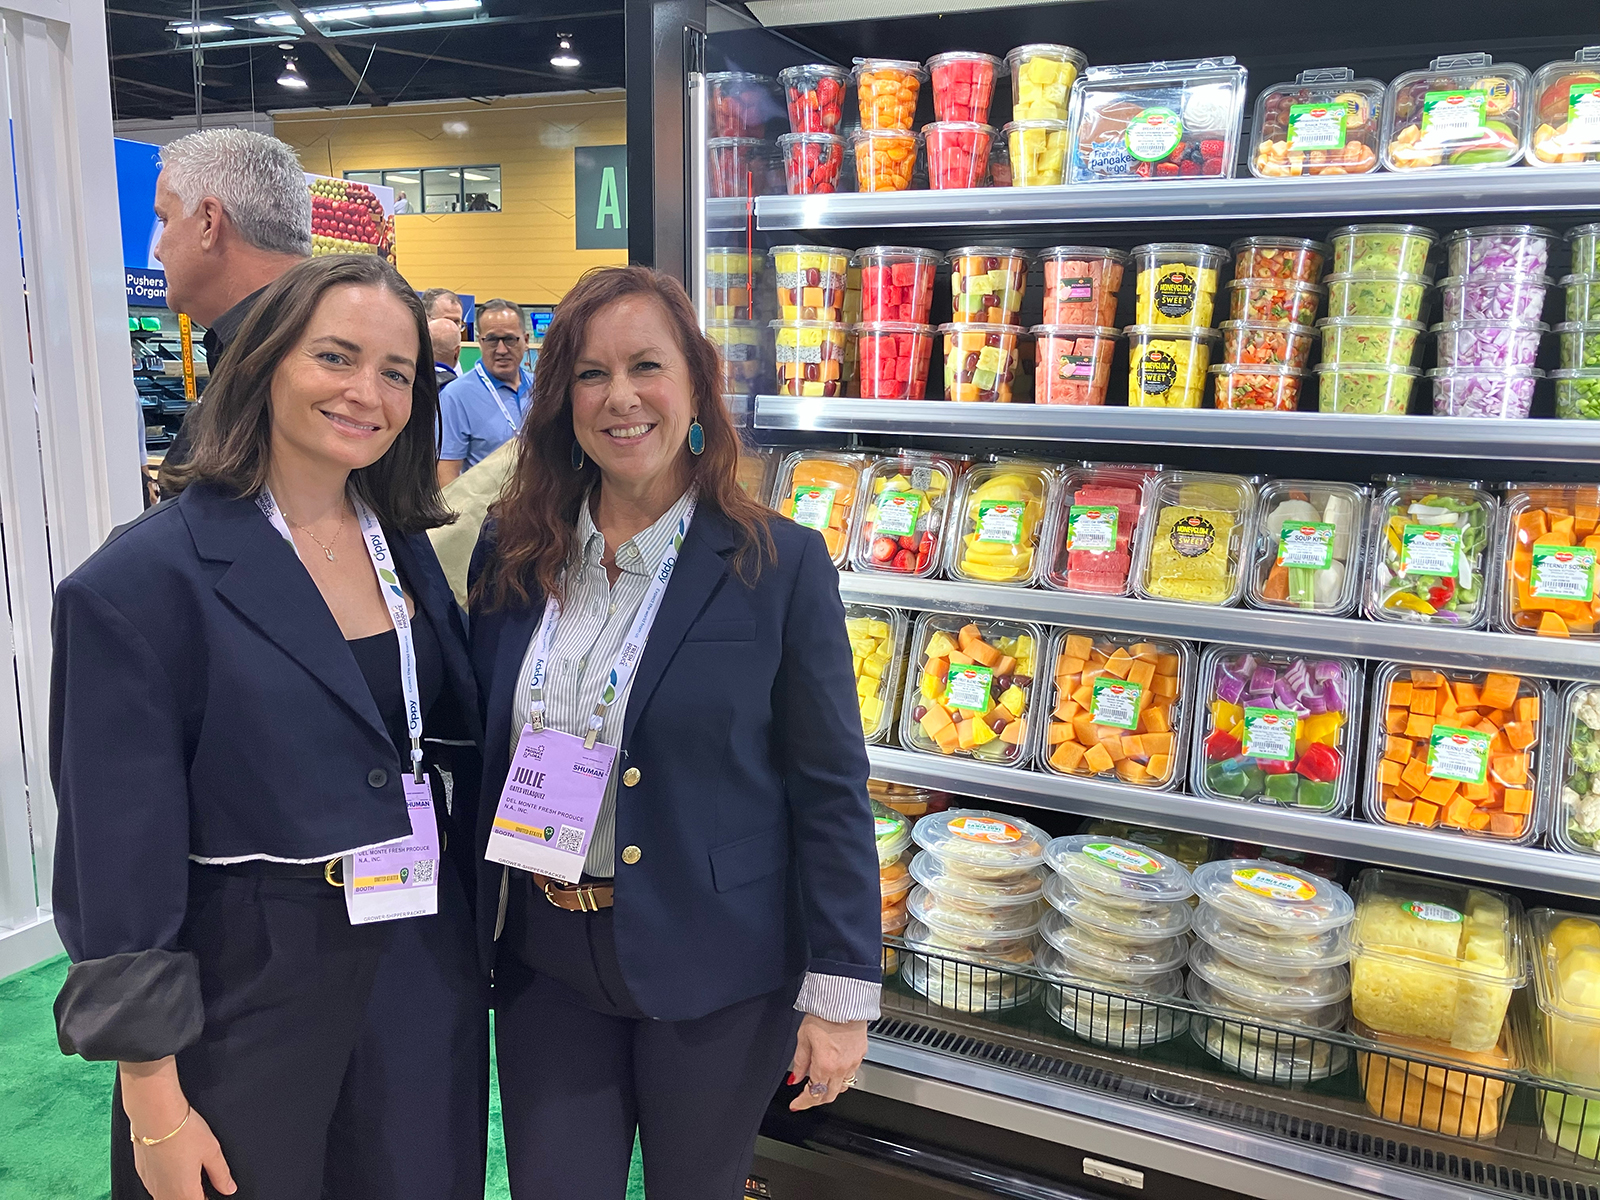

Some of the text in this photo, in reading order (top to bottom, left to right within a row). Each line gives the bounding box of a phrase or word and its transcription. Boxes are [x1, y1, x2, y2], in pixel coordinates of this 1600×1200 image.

[596, 166, 628, 230] A
[127, 274, 164, 287] Pushers
[182, 335, 192, 374] PRESSED
[370, 534, 386, 561] Oppy
[658, 557, 676, 584] Oppy
[531, 658, 544, 687] Oppy
[410, 700, 419, 730] Oppy
[512, 766, 546, 789] JULIE
[573, 764, 604, 777] SHUMAN
[522, 788, 546, 799] VELASQUEZ
[518, 800, 537, 810] MONTE
[538, 806, 557, 815] FRESH
[557, 811, 584, 822] PRODUCE
[494, 829, 514, 838] BOOTH
